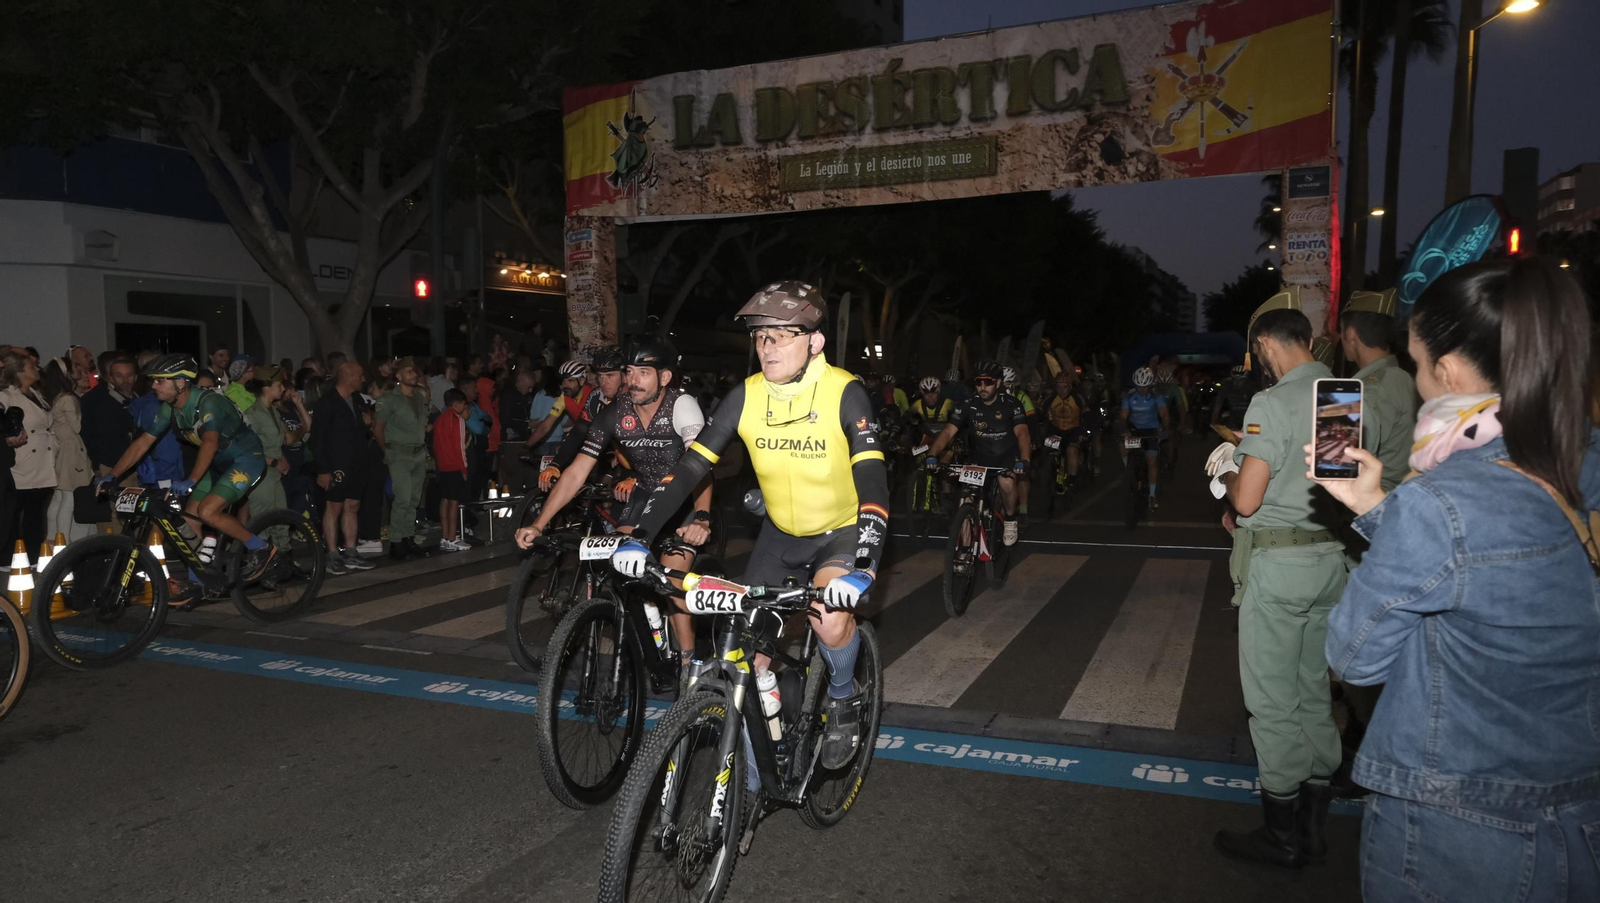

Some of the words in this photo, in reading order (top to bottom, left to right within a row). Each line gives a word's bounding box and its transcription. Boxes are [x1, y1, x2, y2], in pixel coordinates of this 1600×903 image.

[673, 92, 743, 149] LA
[754, 42, 1131, 144] DESÉRTICA
[800, 163, 811, 178] La
[816, 160, 849, 179] Legión
[854, 162, 862, 176] y
[866, 158, 876, 172] el
[880, 152, 922, 172] desierto
[927, 154, 946, 168] nos
[952, 152, 972, 165] une
[1288, 232, 1326, 240] GRUPO
[1288, 239, 1327, 250] RENTA
[755, 436, 826, 452] GUZMÁN
[800, 452, 827, 460] BUENO
[963, 470, 984, 481] 6192
[160, 518, 207, 573] SCOTT
[695, 590, 738, 612] 8423
[293, 666, 400, 684] cajamar
[913, 742, 1080, 769] cajamar
[988, 758, 1022, 769] CAJA
[1026, 763, 1070, 774] RURAL
